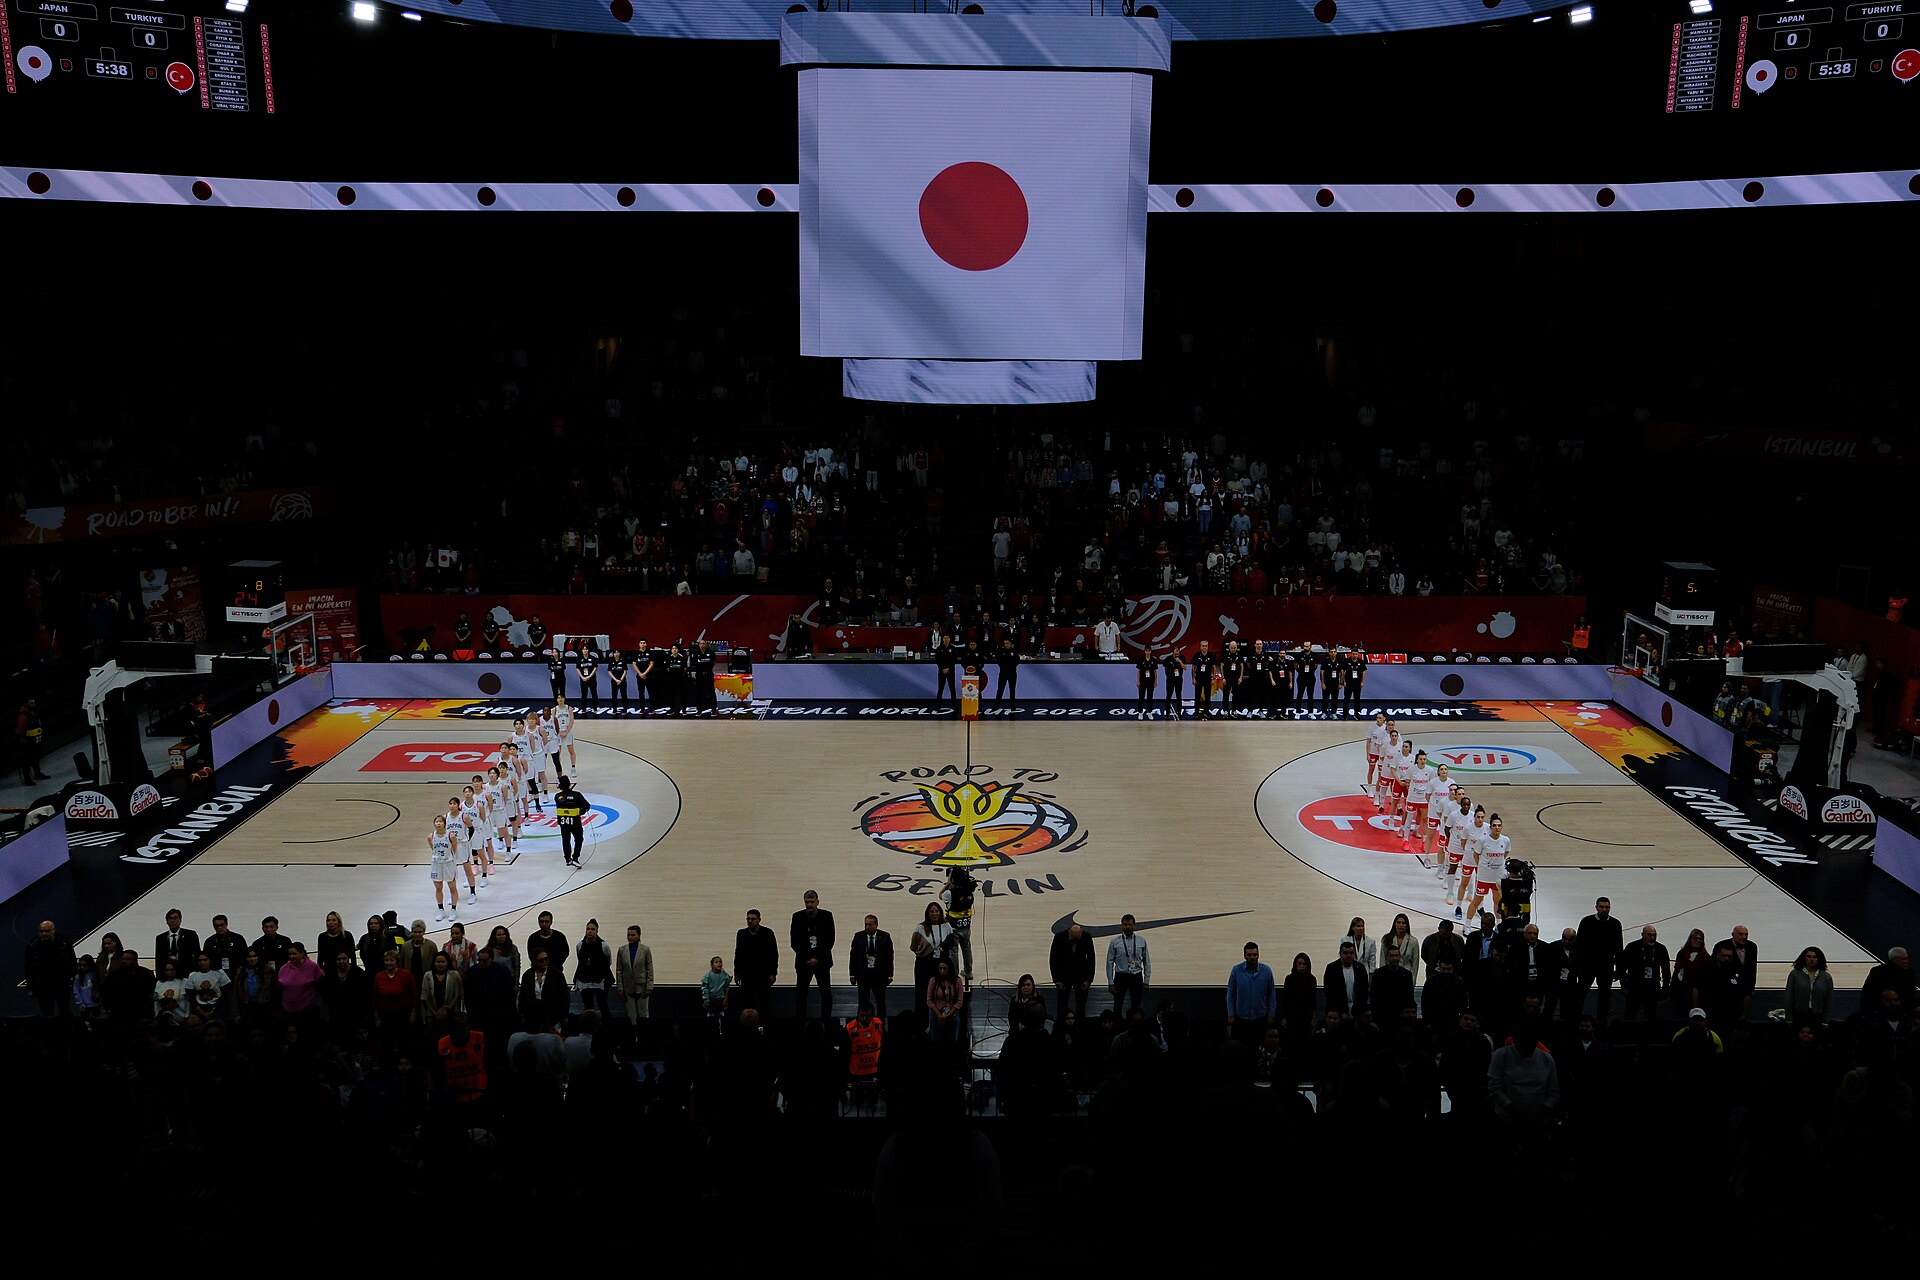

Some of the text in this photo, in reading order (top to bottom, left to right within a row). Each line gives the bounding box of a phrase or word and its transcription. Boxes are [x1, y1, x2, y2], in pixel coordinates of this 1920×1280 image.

[39, 3, 68, 13] JAPAN
[1862, 4, 1902, 15] TURKIYE
[125, 13, 164, 24] TURKIYE
[1777, 14, 1805, 24] JAPAN
[54, 23, 66, 37] 0
[1877, 24, 1889, 37] 0
[144, 32, 156, 46] 0
[1786, 33, 1798, 46] 0
[95, 63, 128, 76] 5:38
[1819, 62, 1851, 75] 5:38
[86, 509, 144, 535] ROAD
[146, 510, 163, 523] TO
[234, 591, 258, 607] 24
[462, 706, 531, 715] FIBA
[858, 707, 955, 715] WORLD
[1032, 708, 1100, 716] 2026
[1440, 753, 1511, 765] Yili
[879, 765, 1060, 783] ROAD TO
[75, 795, 105, 805] 百岁山
[1831, 799, 1861, 809] 百岁山
[560, 816, 575, 826] 341
[866, 873, 1066, 898] BELIN
